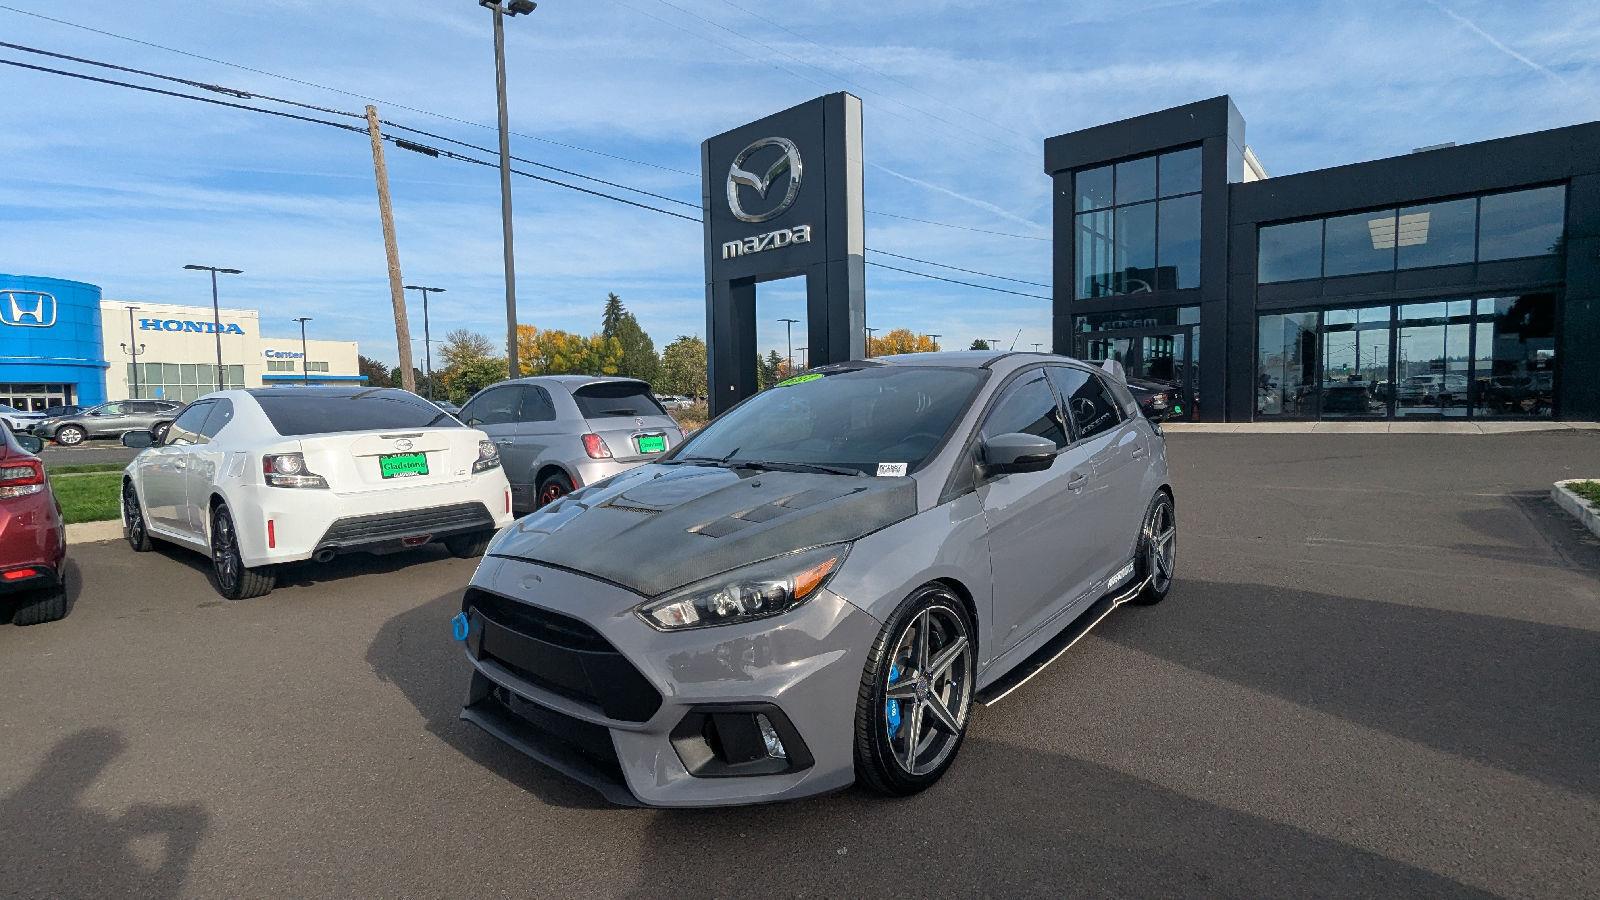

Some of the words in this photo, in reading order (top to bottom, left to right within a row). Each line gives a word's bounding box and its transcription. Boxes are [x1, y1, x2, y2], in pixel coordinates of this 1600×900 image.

[722, 224, 811, 260] mazda
[138, 318, 245, 336] HONDA
[264, 349, 305, 359] Center
[383, 461, 426, 471] Gladstone
